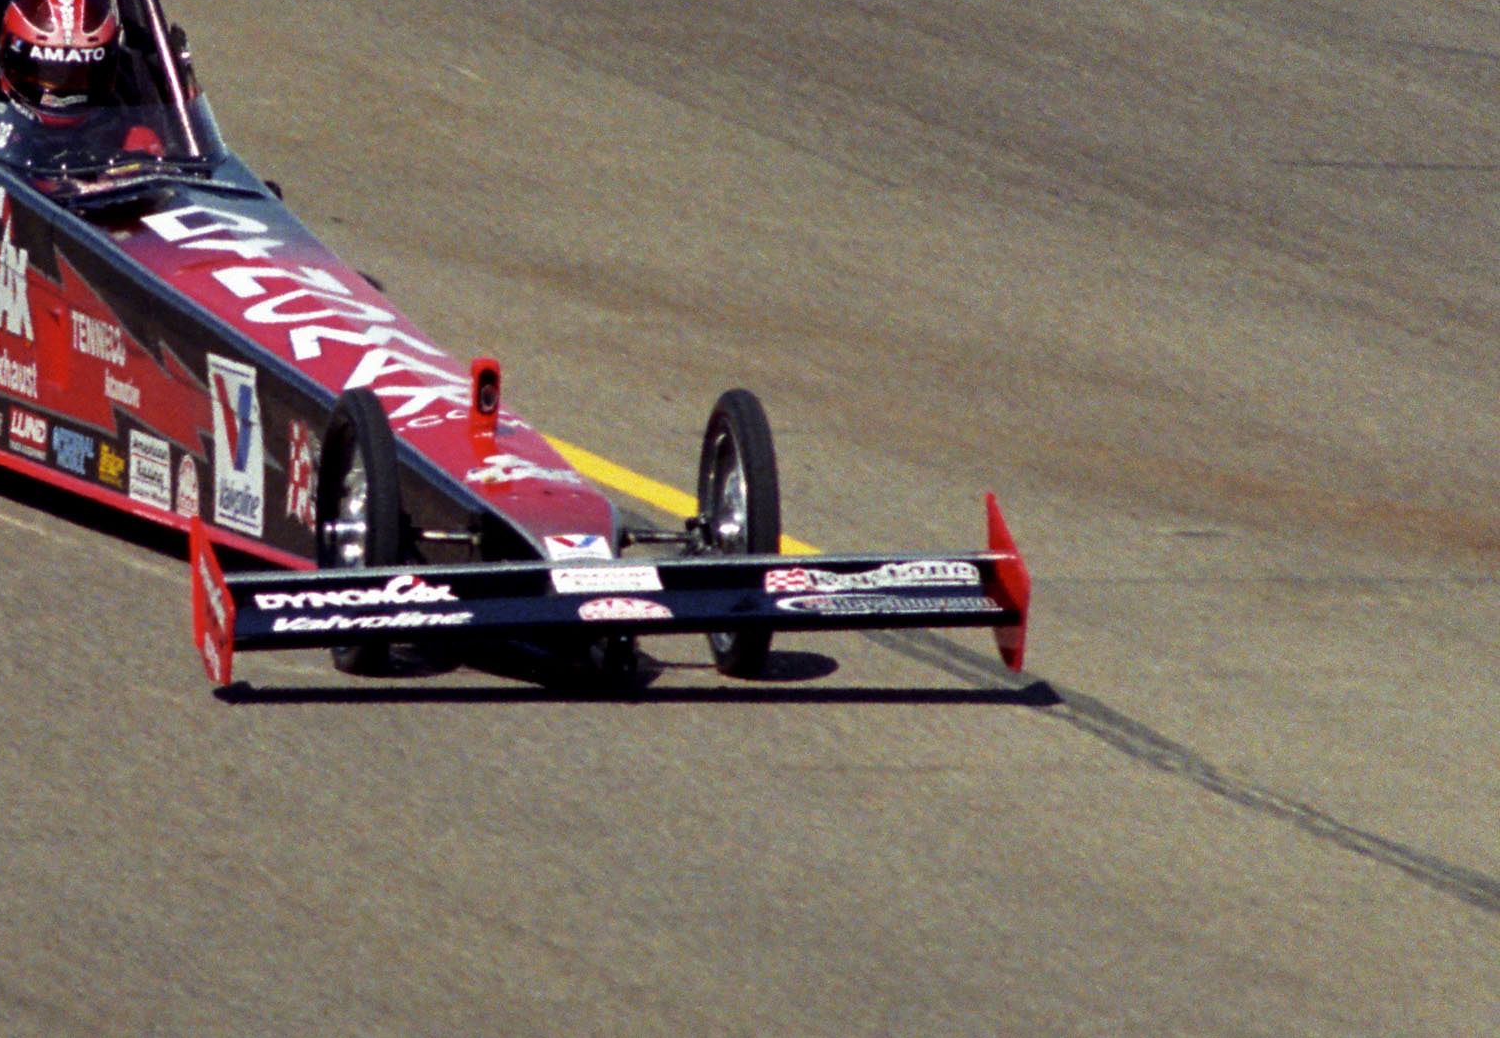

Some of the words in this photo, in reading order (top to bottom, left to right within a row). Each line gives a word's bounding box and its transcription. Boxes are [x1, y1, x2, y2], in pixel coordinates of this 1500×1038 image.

[30, 45, 105, 62] AMATO
[254, 574, 460, 610] DYNOMAX
[273, 612, 474, 632] Valvoline
